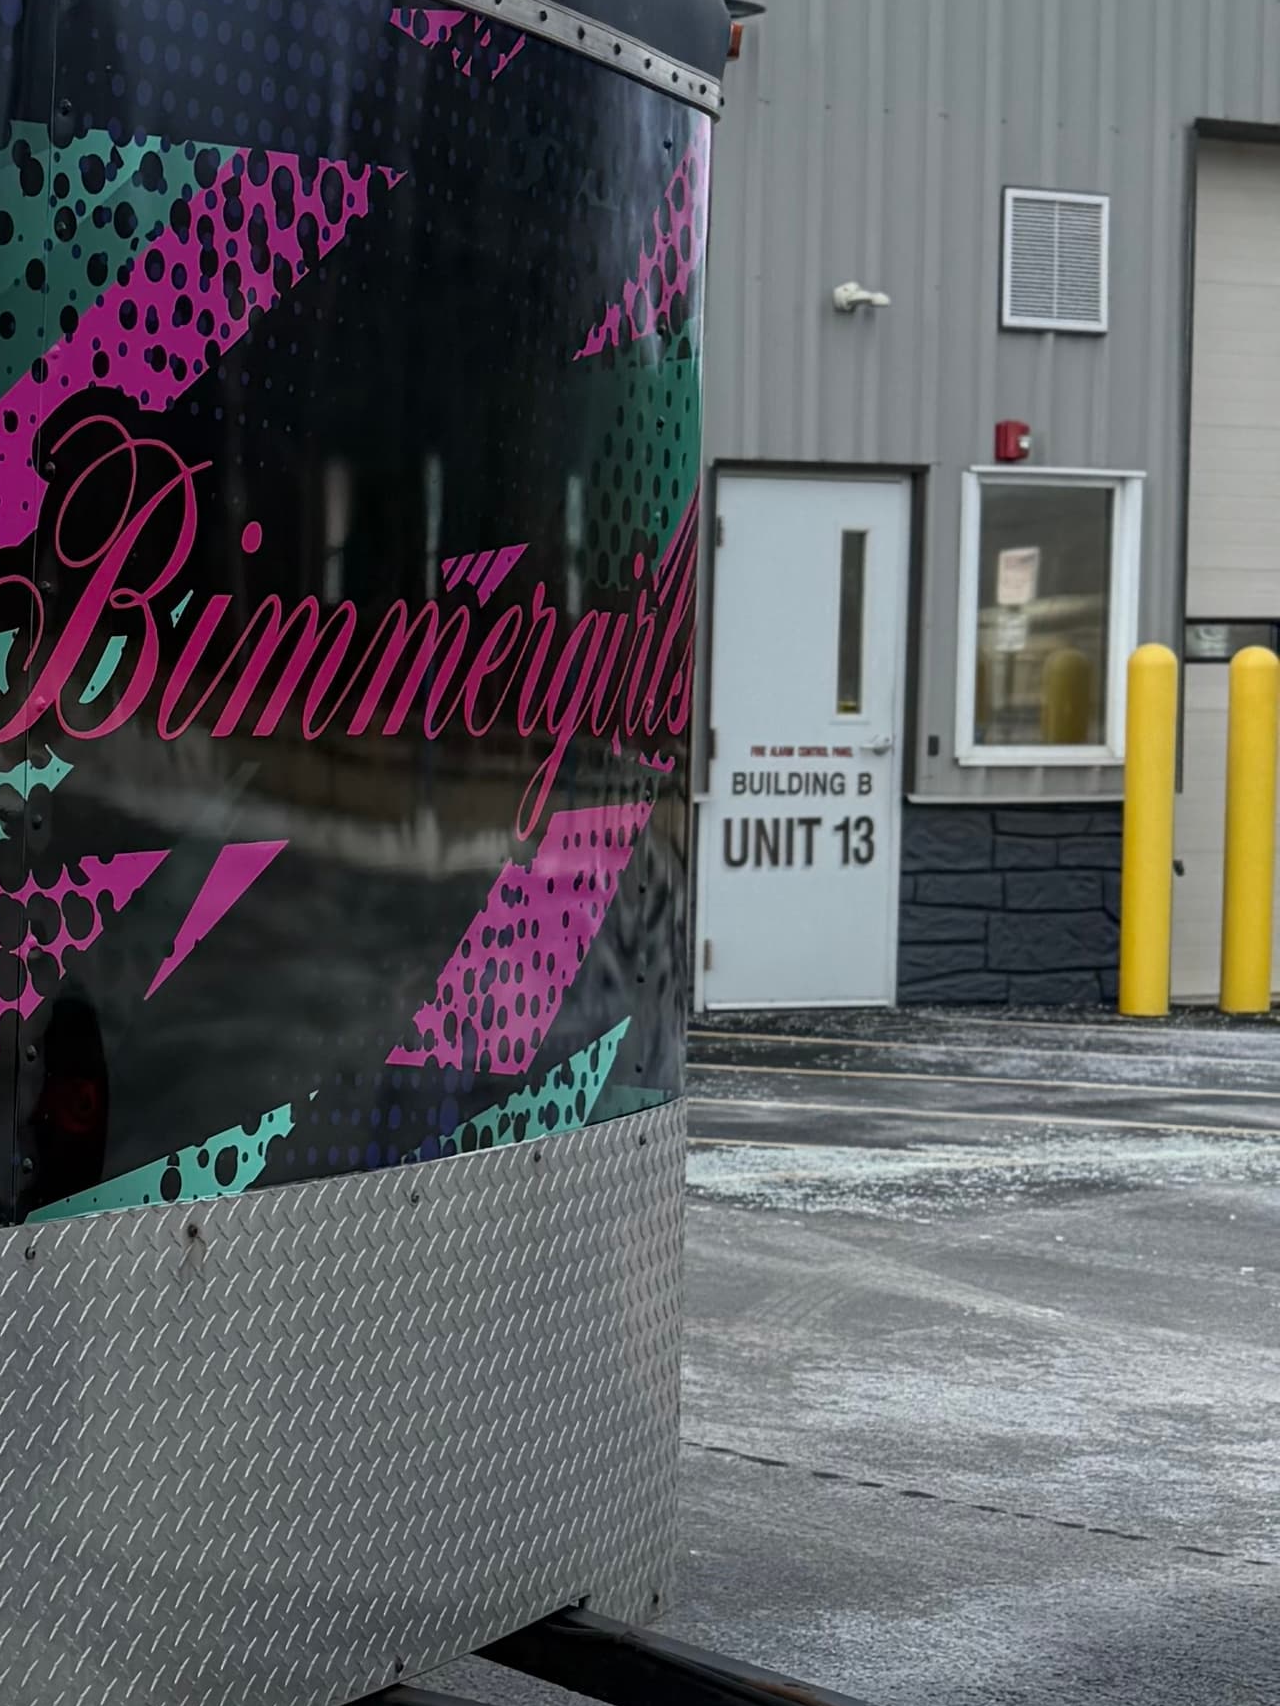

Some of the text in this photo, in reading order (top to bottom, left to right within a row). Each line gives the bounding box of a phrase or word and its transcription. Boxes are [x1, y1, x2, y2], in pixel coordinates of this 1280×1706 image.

[731, 772, 873, 796] BUILDING B
[723, 815, 875, 869] UNIT 13
